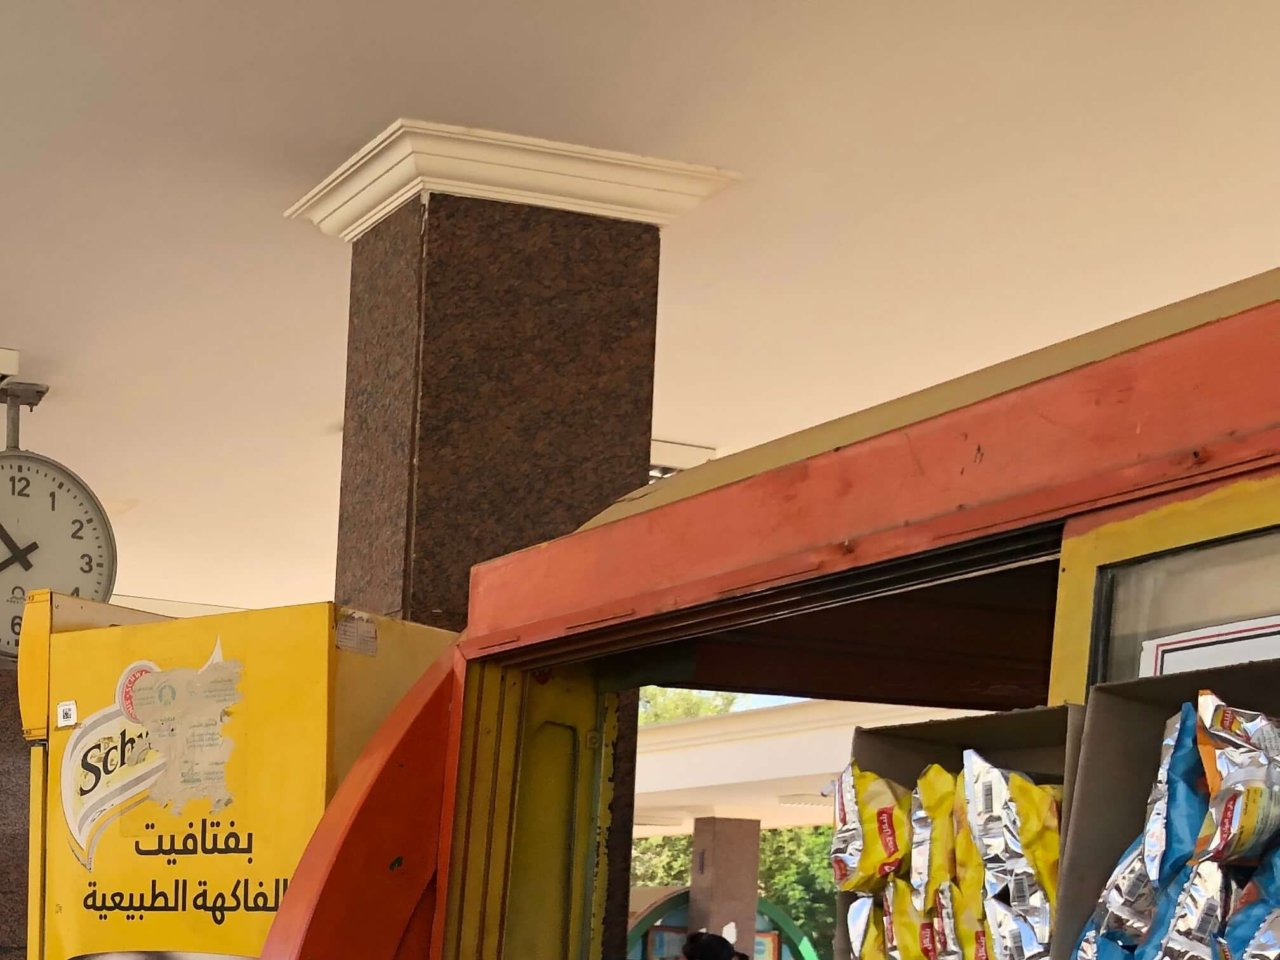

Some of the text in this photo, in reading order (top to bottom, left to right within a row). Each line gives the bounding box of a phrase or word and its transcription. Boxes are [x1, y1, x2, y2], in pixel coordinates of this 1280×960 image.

[9, 477, 30, 497] 12
[49, 491, 56, 511] 1
[71, 519, 84, 540] 2
[80, 554, 93, 573] 3
[135, 819, 253, 865] بفتافيت
[83, 880, 187, 921] الطبيعية
